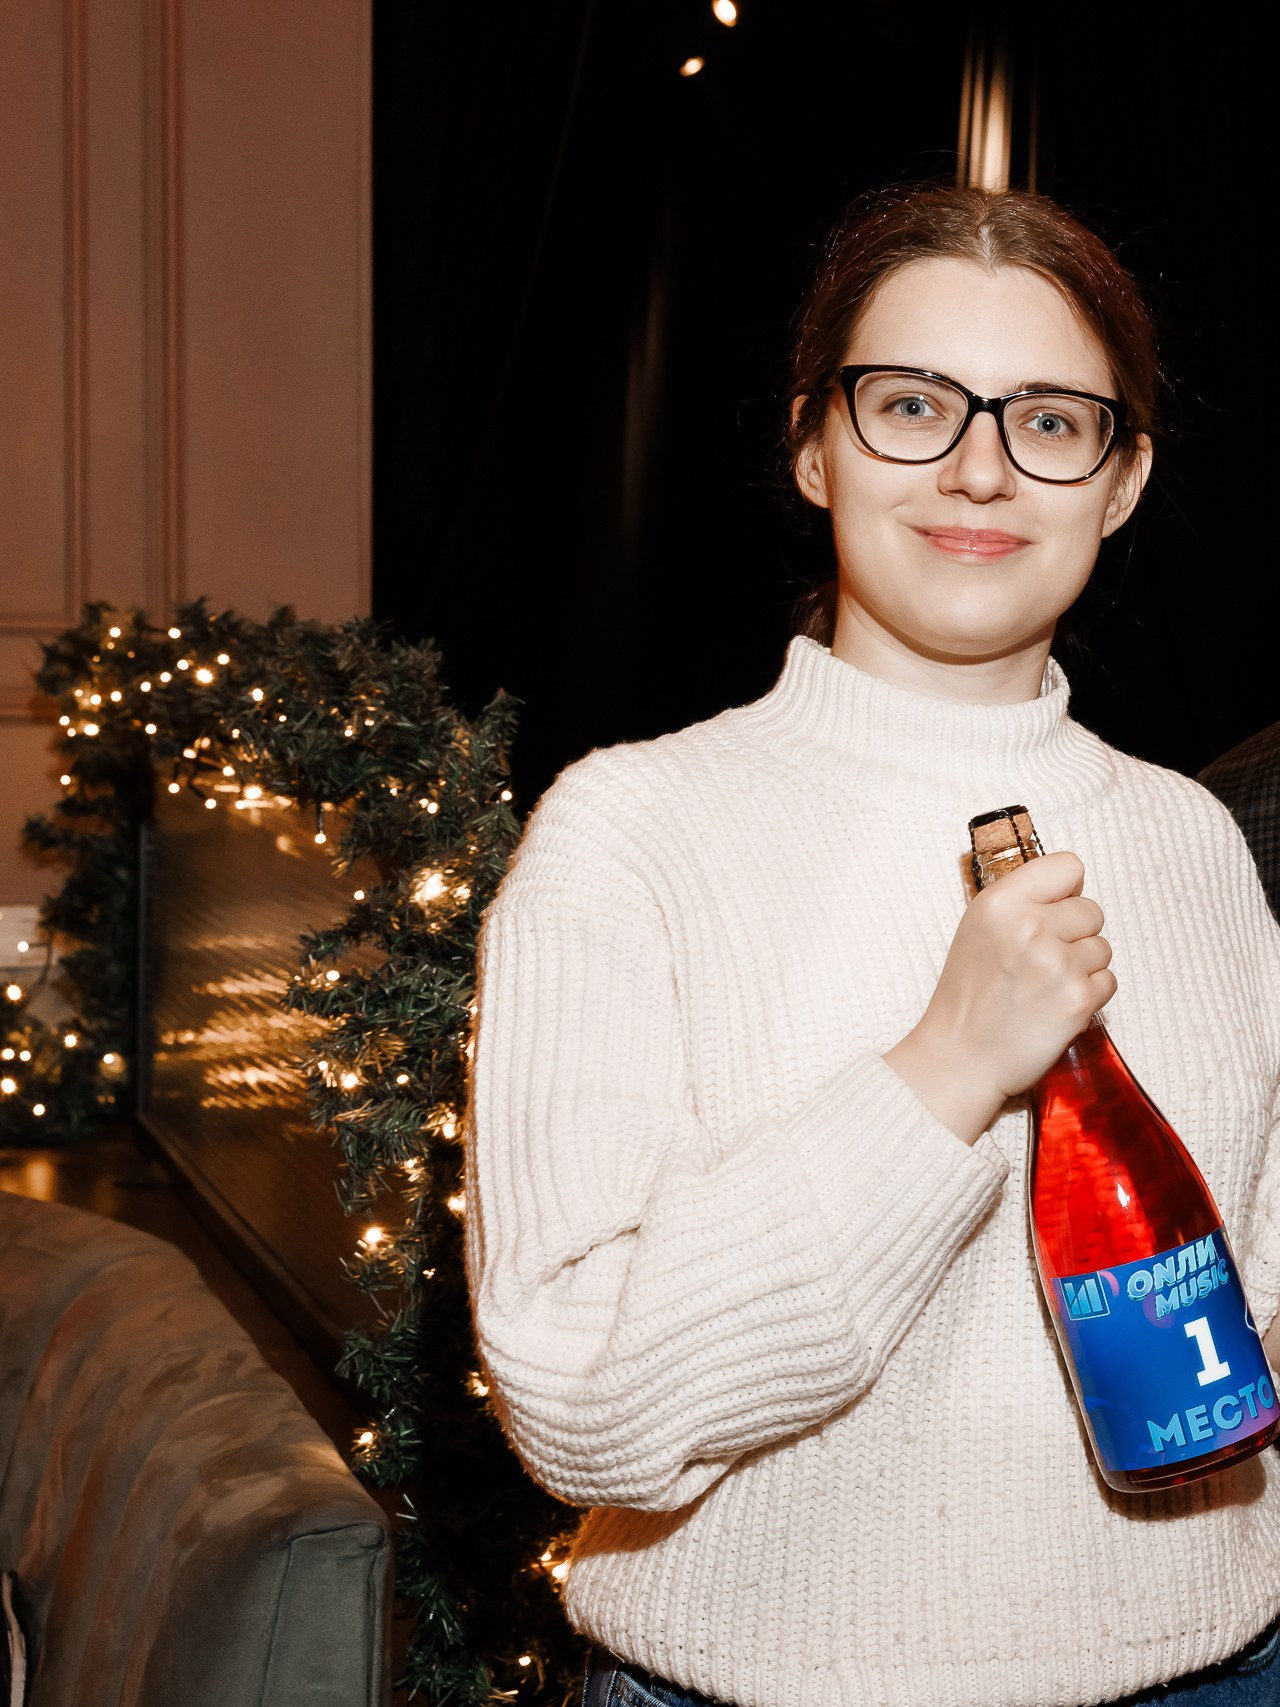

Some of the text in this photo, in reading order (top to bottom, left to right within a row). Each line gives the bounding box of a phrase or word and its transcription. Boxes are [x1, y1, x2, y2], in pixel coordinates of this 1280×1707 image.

[1155, 1258, 1229, 1320] MUSIC
[1183, 1316, 1232, 1387] 1
[1147, 1374, 1275, 1452] МЕСТО
